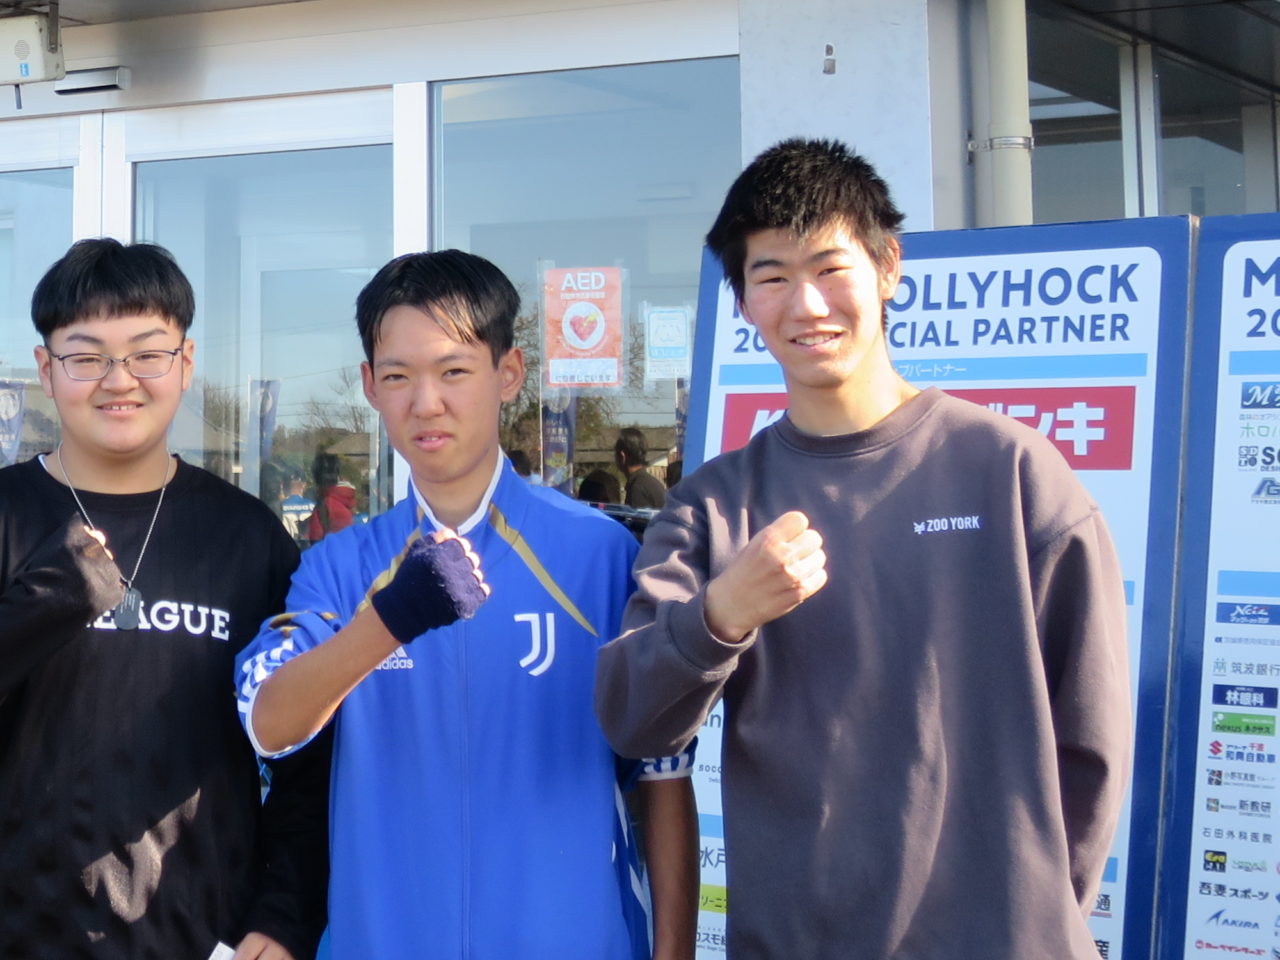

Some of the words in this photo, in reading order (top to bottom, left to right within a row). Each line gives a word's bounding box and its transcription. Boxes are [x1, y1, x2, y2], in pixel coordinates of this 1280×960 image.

[560, 271, 606, 291] AED
[972, 313, 1131, 347] PARTNER
[926, 517, 949, 533] ZOO
[950, 515, 980, 531] YORK
[86, 600, 230, 641] EGUE
[1199, 881, 1270, 901] 吾妻スポーツ
